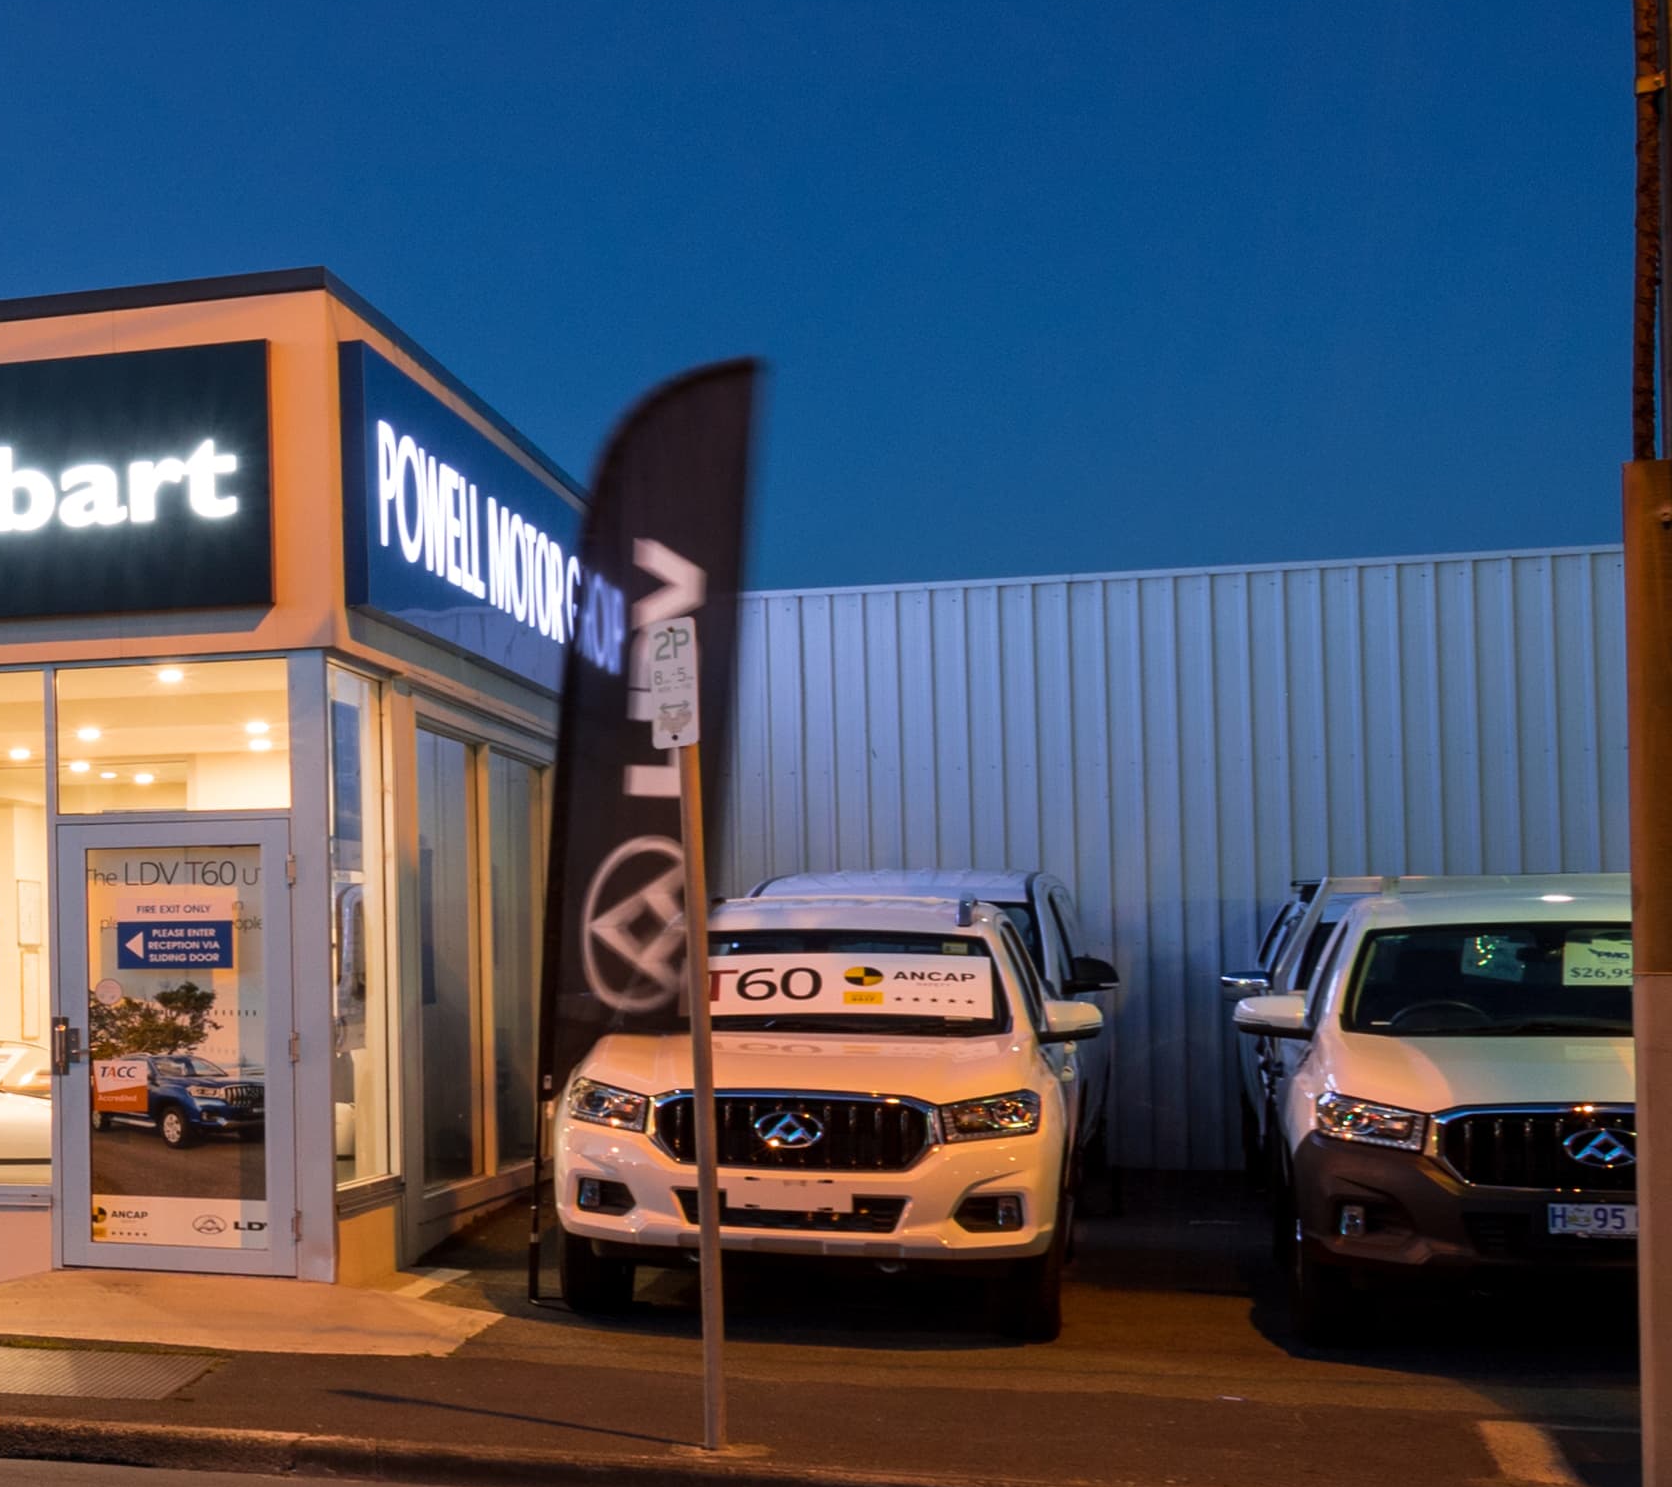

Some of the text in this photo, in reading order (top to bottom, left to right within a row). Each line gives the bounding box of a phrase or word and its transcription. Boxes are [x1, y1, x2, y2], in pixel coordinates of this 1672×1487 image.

[377, 419, 486, 600] POWELL
[487, 496, 565, 645] MOTOR
[653, 627, 690, 662] 2P
[125, 861, 180, 886] LDV
[184, 860, 237, 886] T60
[136, 904, 212, 914] FIRE EXIT ONLY
[152, 928, 216, 938] PLEASE ENTER
[147, 941, 220, 950] RECEPTION VIA
[149, 953, 220, 963] SLIDING DOOR
[1570, 966, 1633, 981] $26,99
[708, 967, 977, 1002] T60 ANCAP
[100, 1066, 137, 1079] TACC
[111, 1210, 148, 1219] ANCAP
[1550, 1207, 1627, 1230] H 95
[234, 1221, 268, 1232] LD
